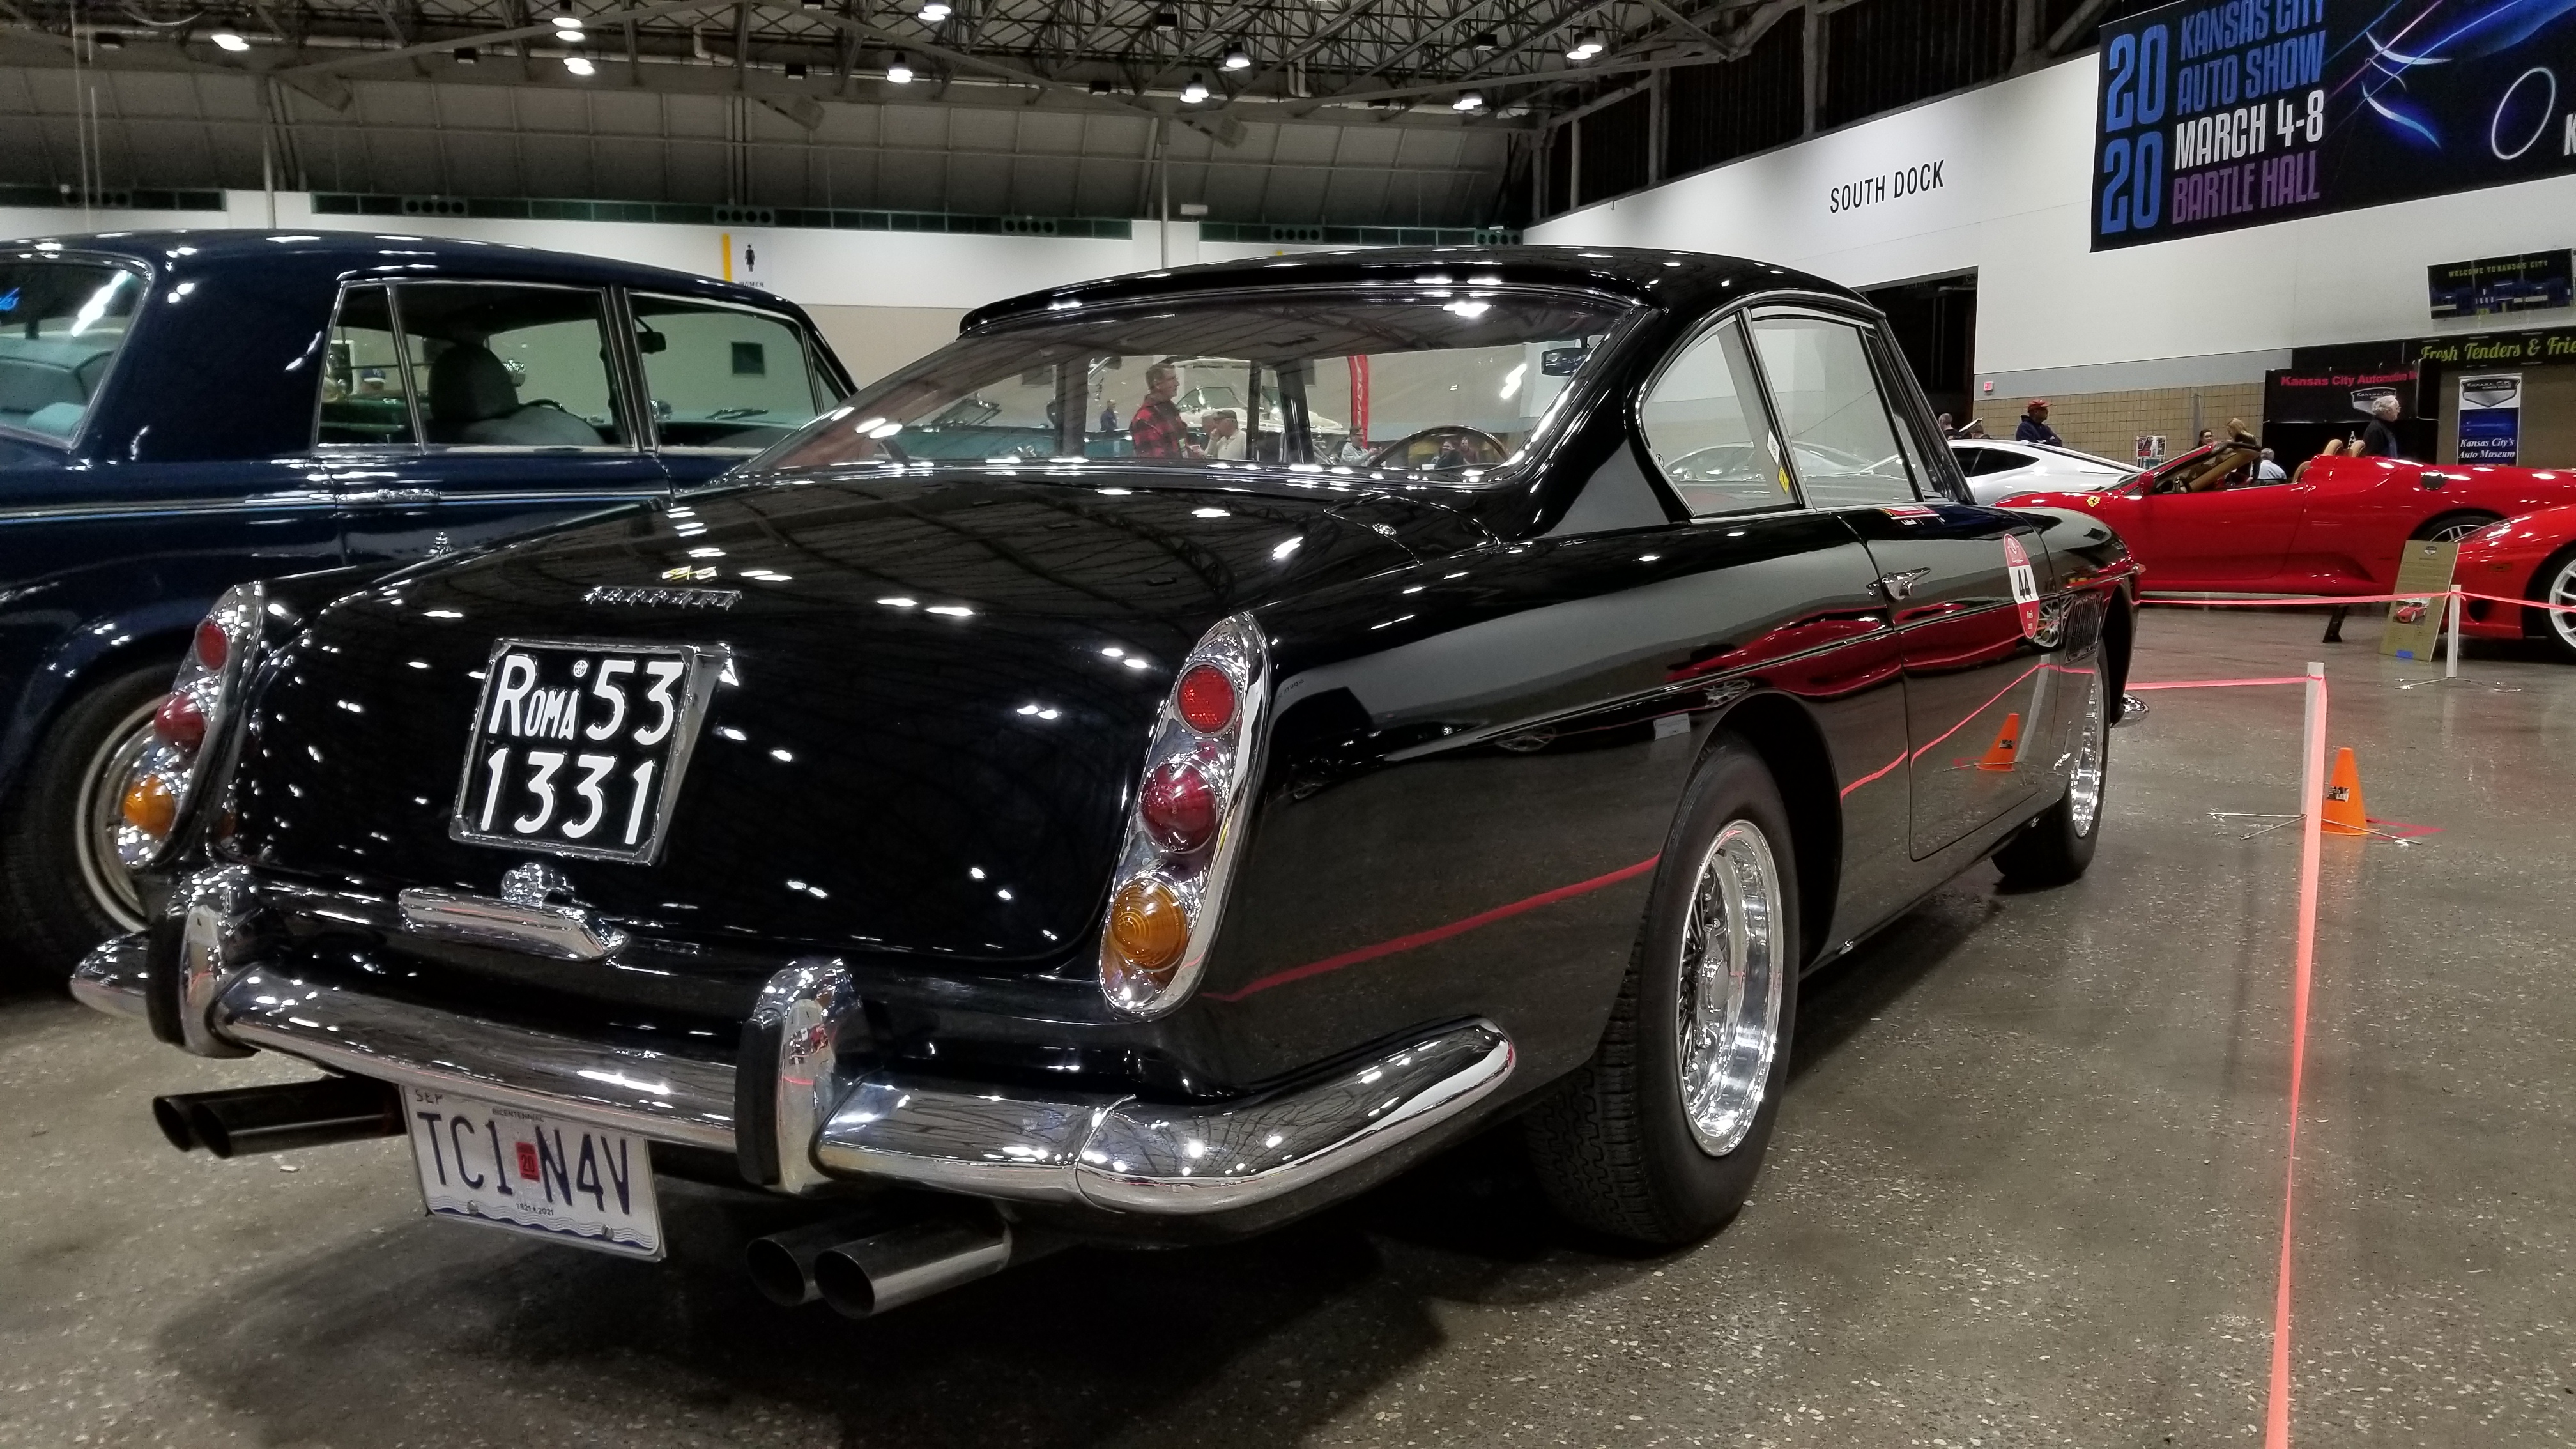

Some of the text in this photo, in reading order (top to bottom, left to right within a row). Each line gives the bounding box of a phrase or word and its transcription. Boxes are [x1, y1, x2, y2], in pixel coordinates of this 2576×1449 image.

[2180, 0, 2269, 61] KANSAS
[2105, 24, 2168, 133] 20
[2177, 30, 2326, 116] AUTO SHOW
[2175, 89, 2324, 171] MARCH 4-8
[1830, 159, 1945, 213] SOUTH DOCK
[2101, 131, 2163, 234] 20
[2173, 150, 2320, 225] BARTLE HALL
[2448, 267, 2483, 278] WELCOME
[2497, 261, 2526, 272] KANSAS
[2530, 259, 2549, 268] CITY
[2281, 376, 2329, 387] Kansas
[2332, 376, 2355, 387] City
[2421, 345, 2458, 362] Fresh
[2464, 342, 2521, 360] Tenders
[2527, 338, 2542, 356] &
[2458, 450, 2516, 459] Auto Museum
[2460, 439, 2489, 447] Kansas
[2018, 568, 2033, 601] 44
[586, 659, 684, 746] 53
[480, 748, 656, 845] 1331
[417, 1110, 631, 1215] TC1 N4V
